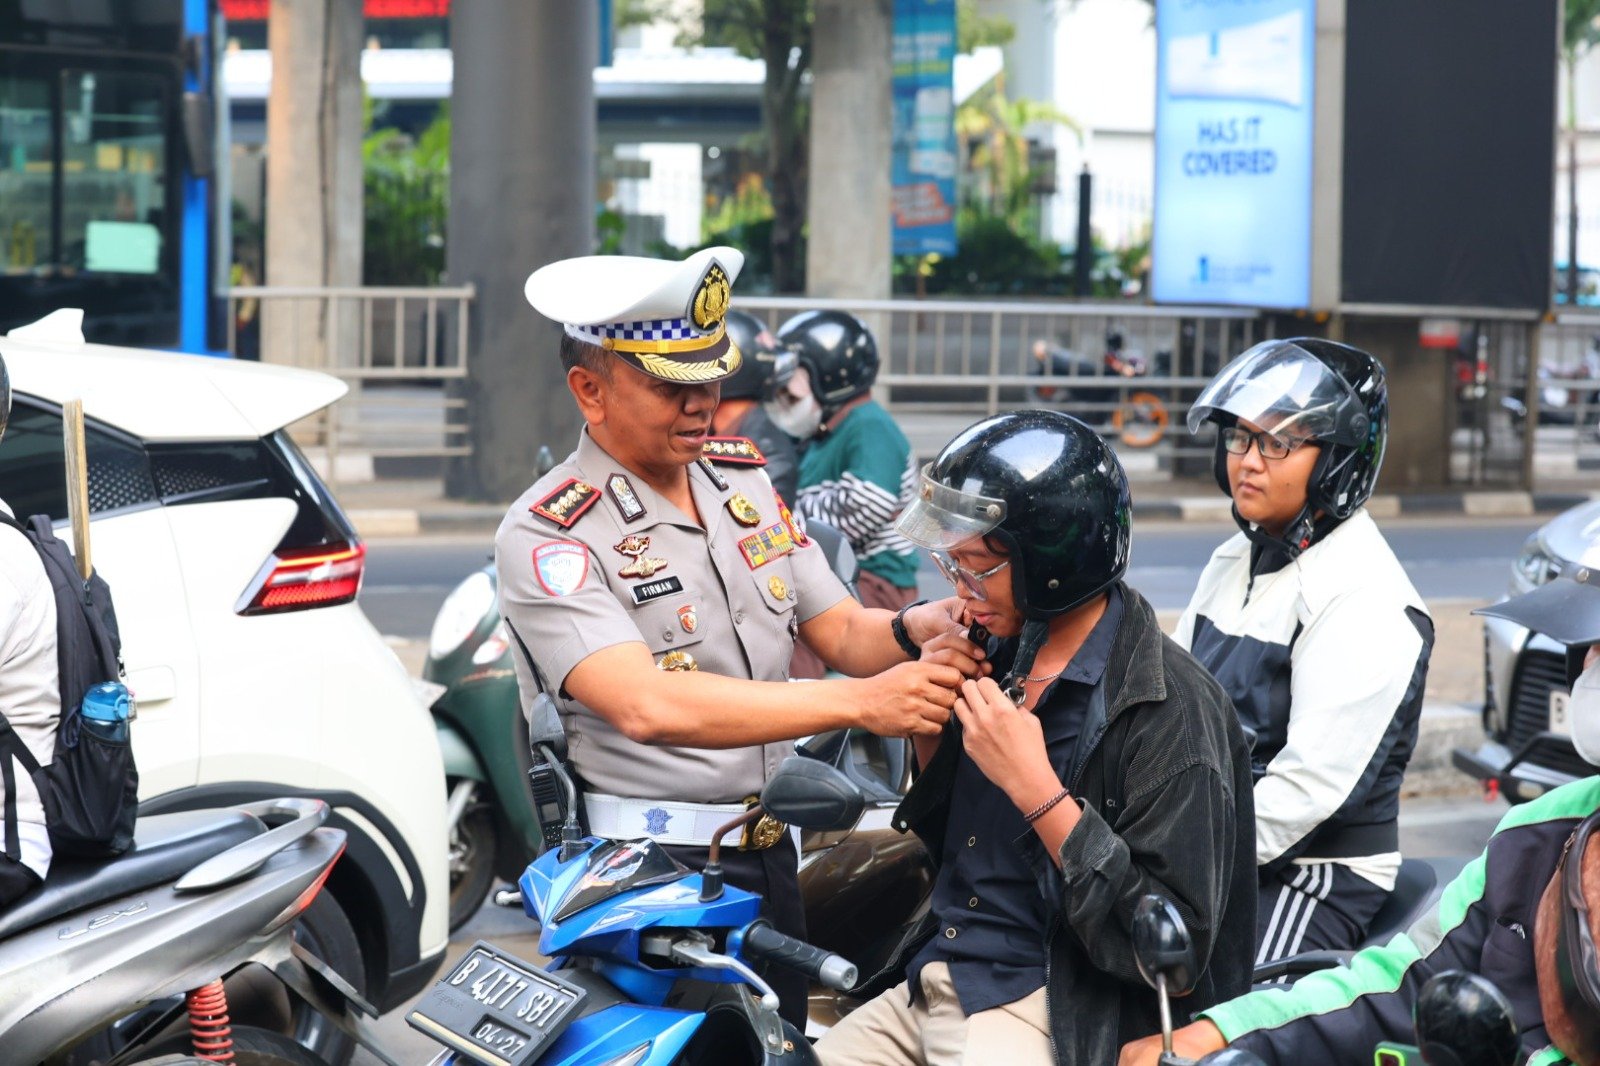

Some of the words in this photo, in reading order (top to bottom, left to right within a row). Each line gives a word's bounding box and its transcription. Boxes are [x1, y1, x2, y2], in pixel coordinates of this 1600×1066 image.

[1197, 118, 1239, 143] HAS
[1244, 117, 1262, 142] IT
[1182, 149, 1278, 176] COVERED
[641, 580, 673, 597] FIRMAN
[451, 957, 480, 986] B
[470, 966, 528, 1010] 4177
